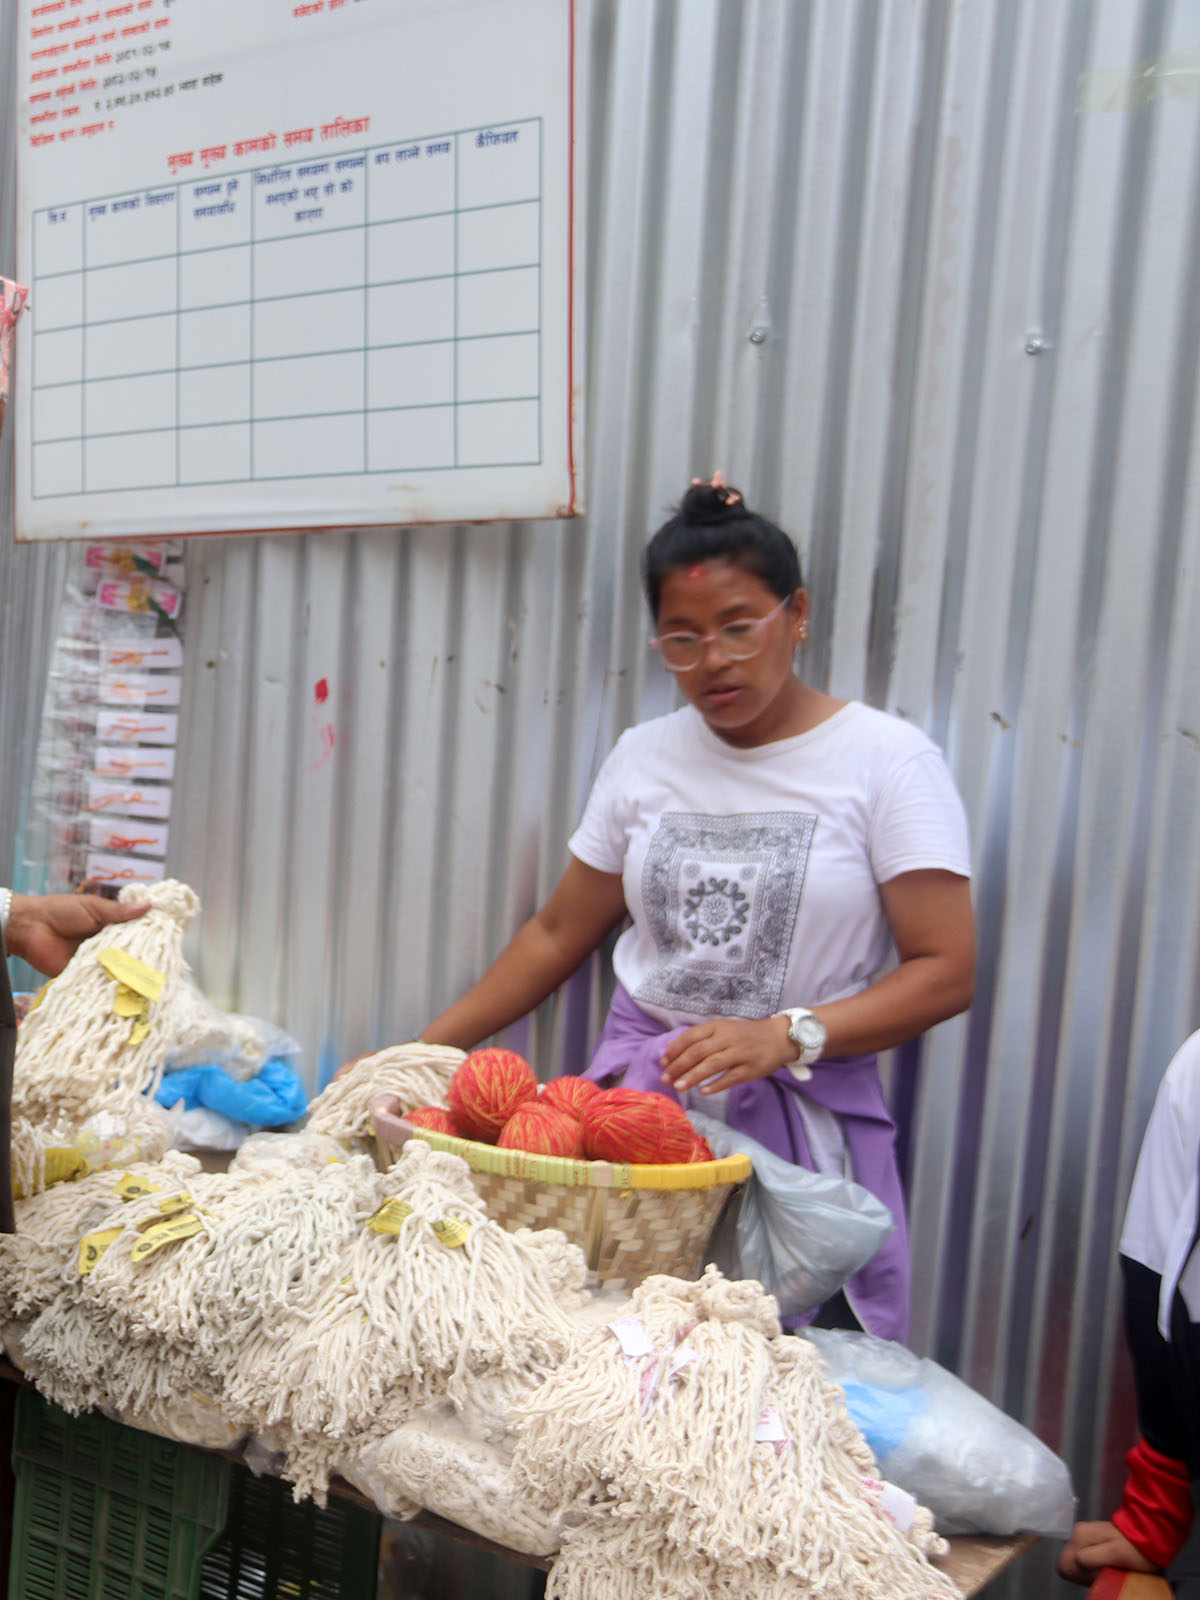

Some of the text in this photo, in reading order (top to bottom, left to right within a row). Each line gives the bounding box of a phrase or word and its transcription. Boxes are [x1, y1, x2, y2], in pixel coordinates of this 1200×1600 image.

[168, 116, 371, 174] मुख्य मुख्य कामको समय तालिका
